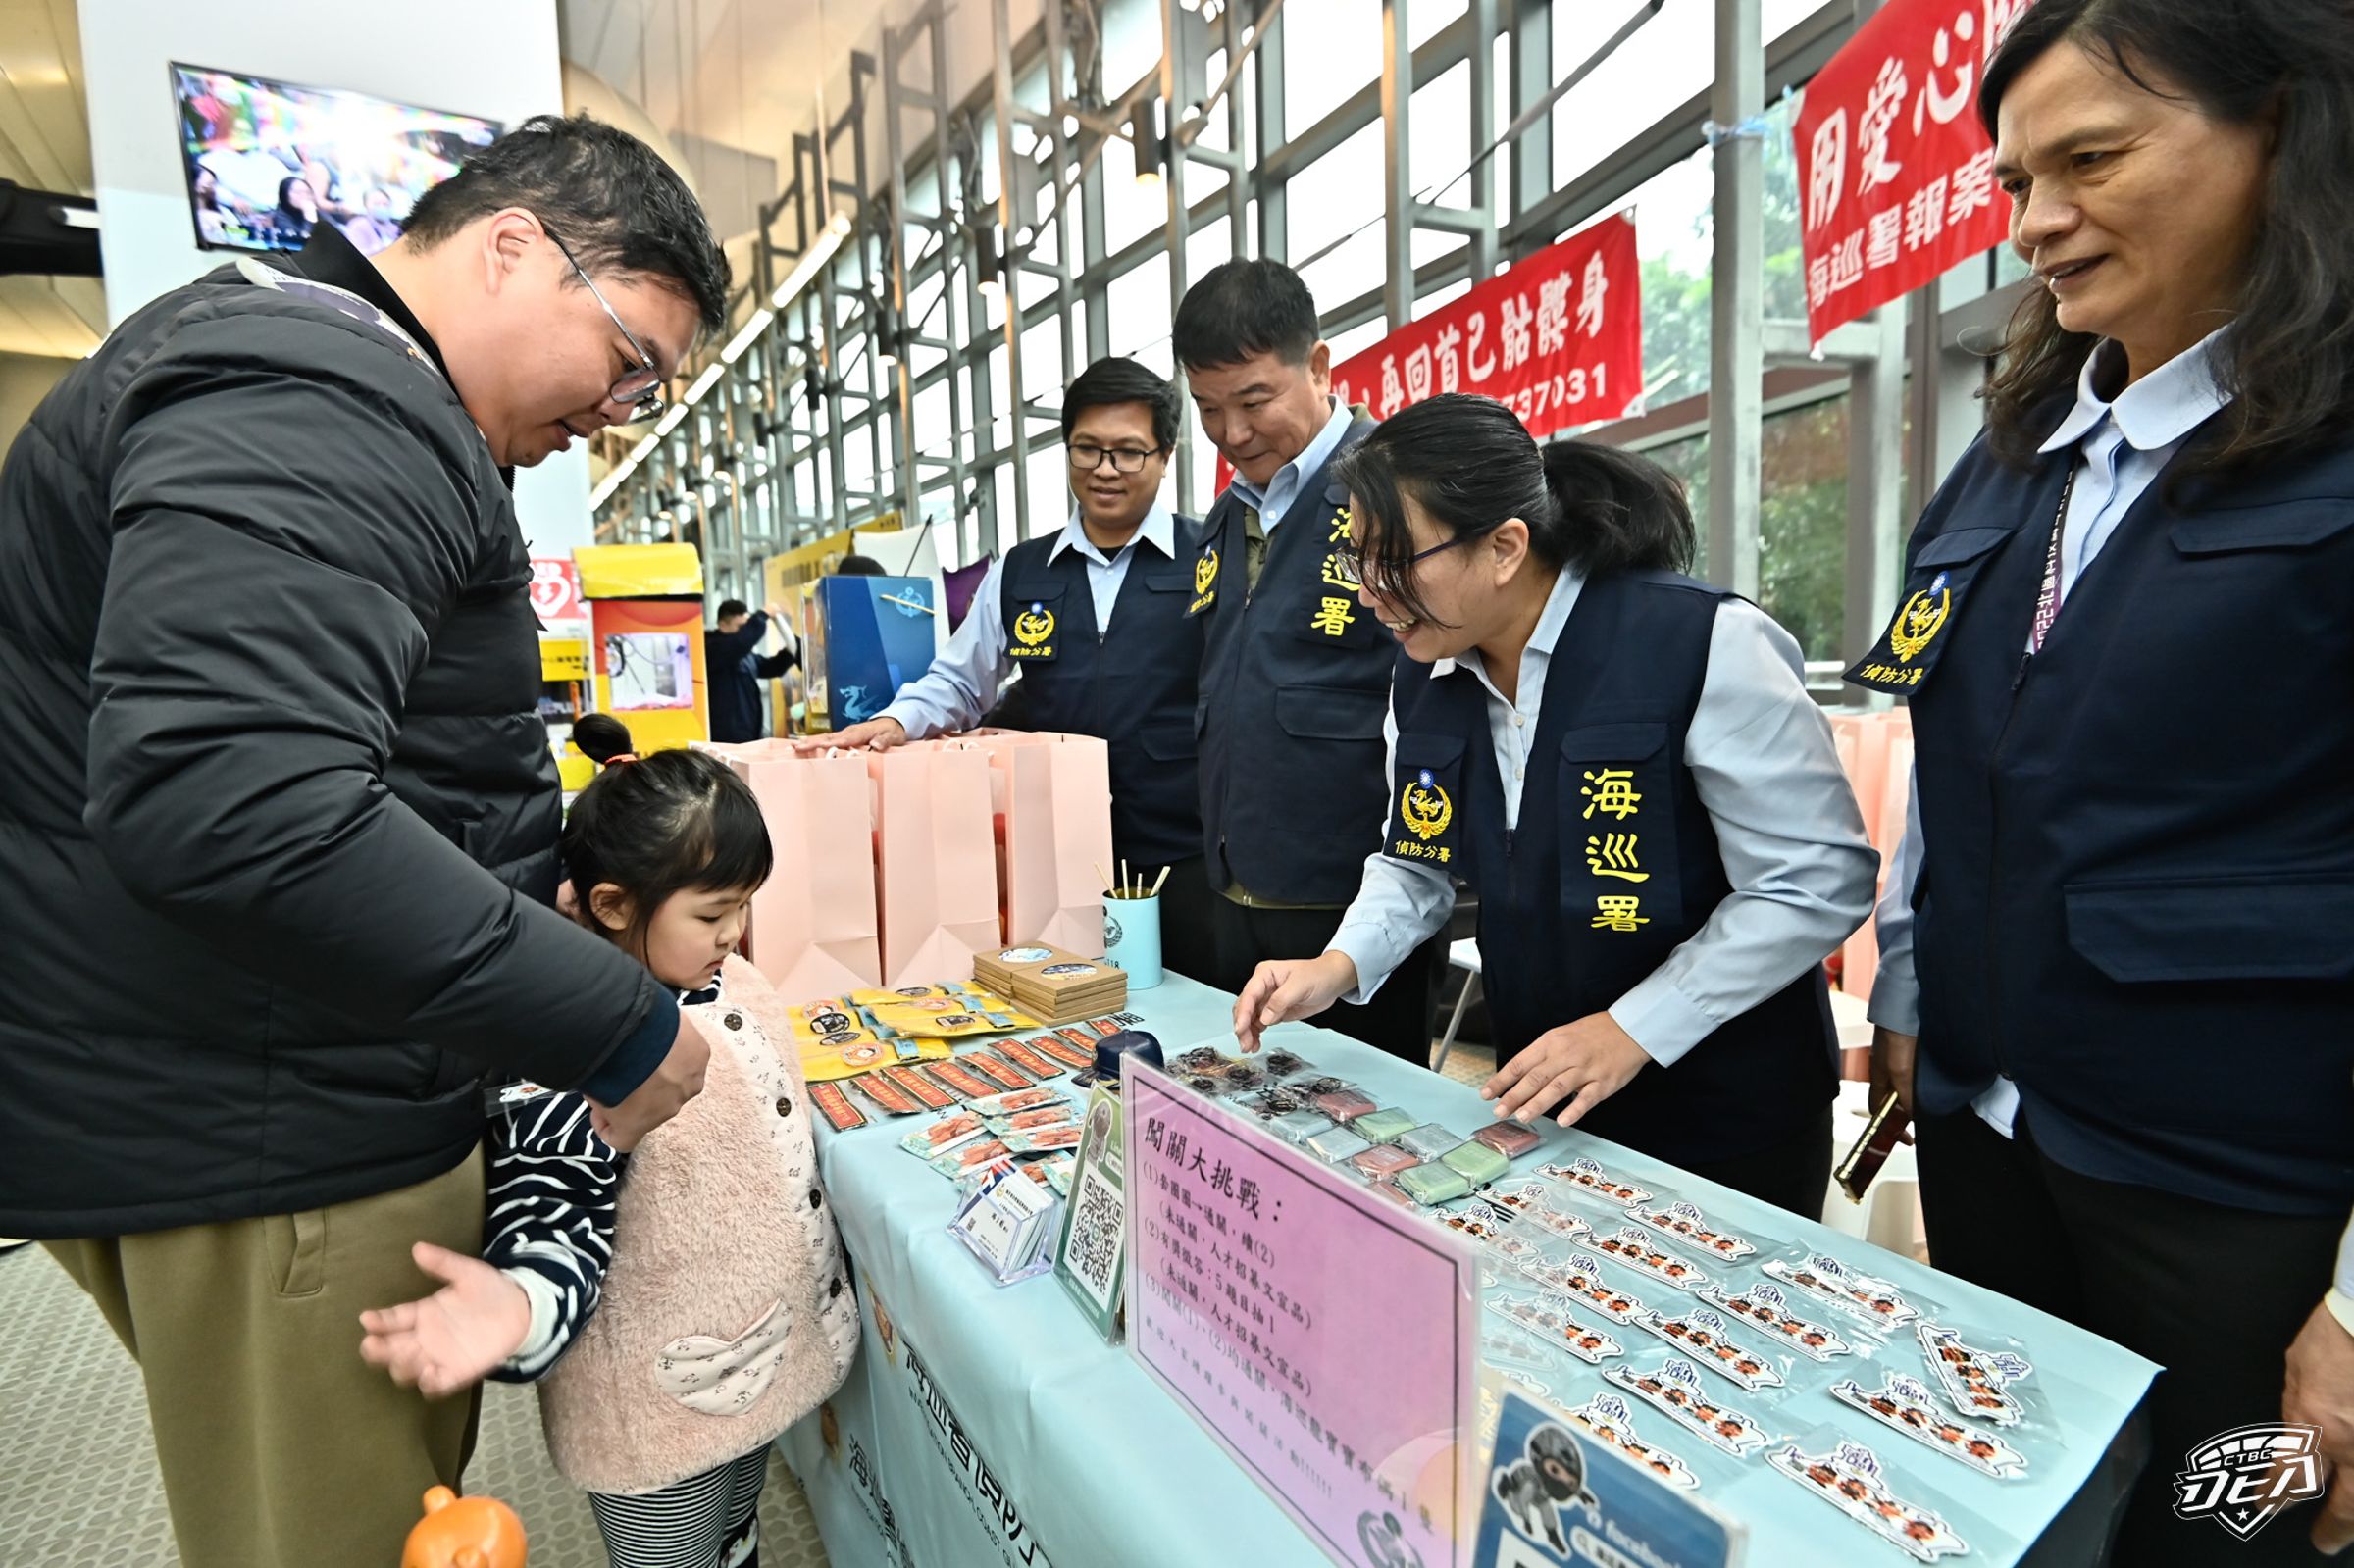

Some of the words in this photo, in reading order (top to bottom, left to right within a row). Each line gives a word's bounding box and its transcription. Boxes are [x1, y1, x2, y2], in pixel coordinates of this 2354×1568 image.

[1860, 663, 1924, 684] 偵防分署
[1395, 840, 1452, 863] 偵防分署
[1580, 768, 1650, 932] 海巡署
